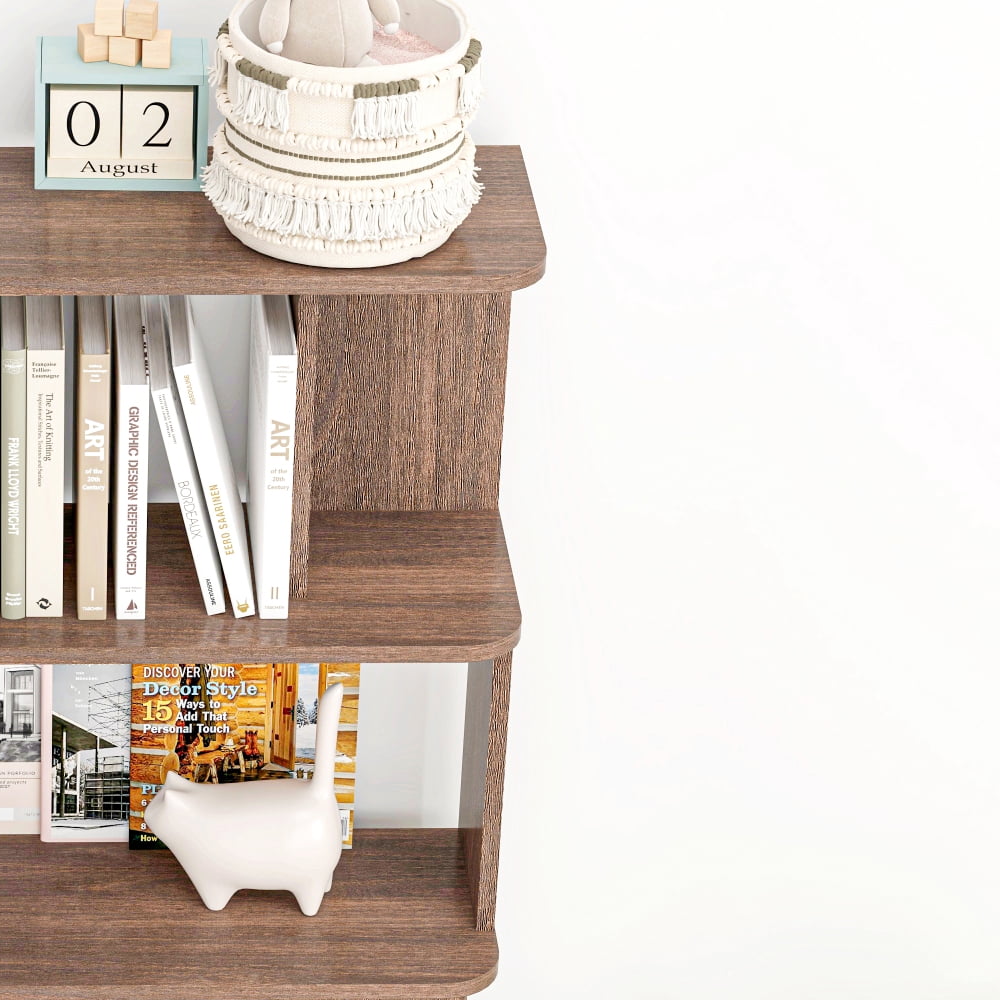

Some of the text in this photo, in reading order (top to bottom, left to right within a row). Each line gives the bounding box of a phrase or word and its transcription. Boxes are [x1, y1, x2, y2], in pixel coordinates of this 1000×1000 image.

[80, 160, 158, 178] August
[43, 393, 54, 462] The Art of Knitting
[84, 418, 105, 462] ART
[128, 406, 139, 456] GRAPHIC
[270, 419, 290, 461] ART
[7, 437, 20, 536] FRANK LLOYD WRIGHT
[127, 460, 139, 501] DESIGN
[178, 480, 202, 540] BORDEAUX
[208, 484, 235, 556] EERO SAARINEN
[126, 504, 138, 576] REFERENCED
[143, 664, 235, 678] DISCOVER YOUR
[143, 680, 258, 700] Decor Style
[142, 699, 173, 721] 15
[175, 699, 221, 711] Ways to
[175, 712, 228, 722] Add That
[143, 723, 230, 734] Personal Touch
